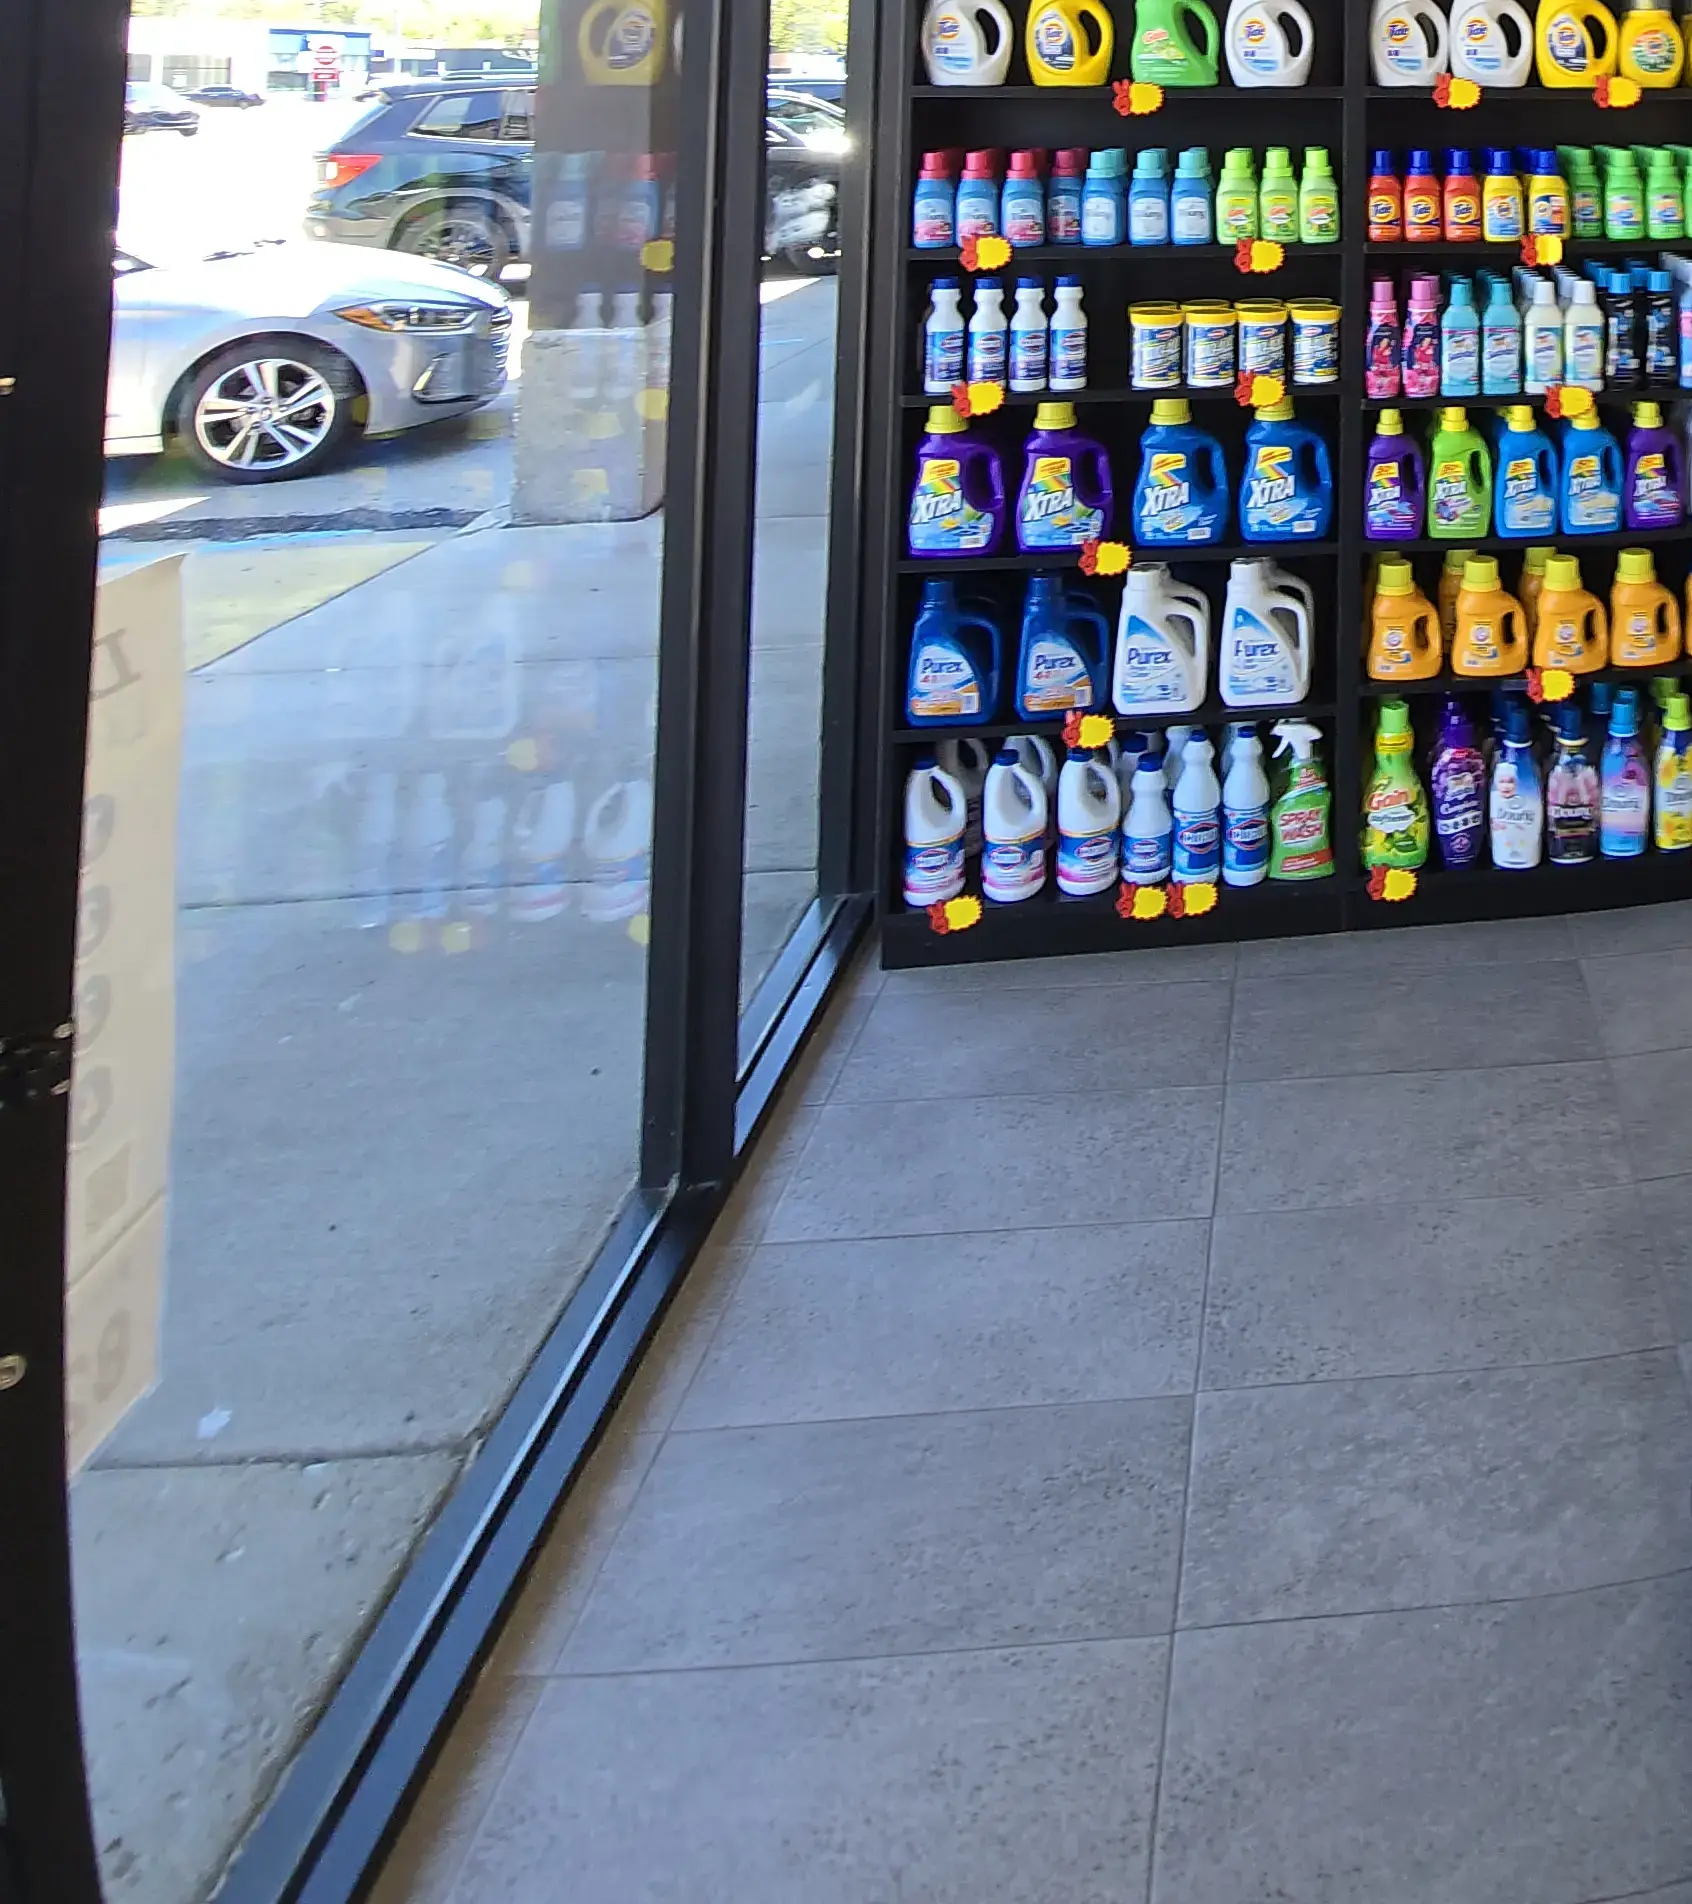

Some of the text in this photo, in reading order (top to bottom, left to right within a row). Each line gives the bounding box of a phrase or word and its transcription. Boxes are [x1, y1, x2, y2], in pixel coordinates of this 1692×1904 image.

[912, 489, 965, 524] XTRA
[1025, 489, 1074, 521] XTRA
[1142, 481, 1190, 515] XTRA
[1250, 476, 1295, 509] XTRA
[919, 655, 964, 674] Purex
[1034, 653, 1078, 671] Purex
[1126, 645, 1174, 667] Purex
